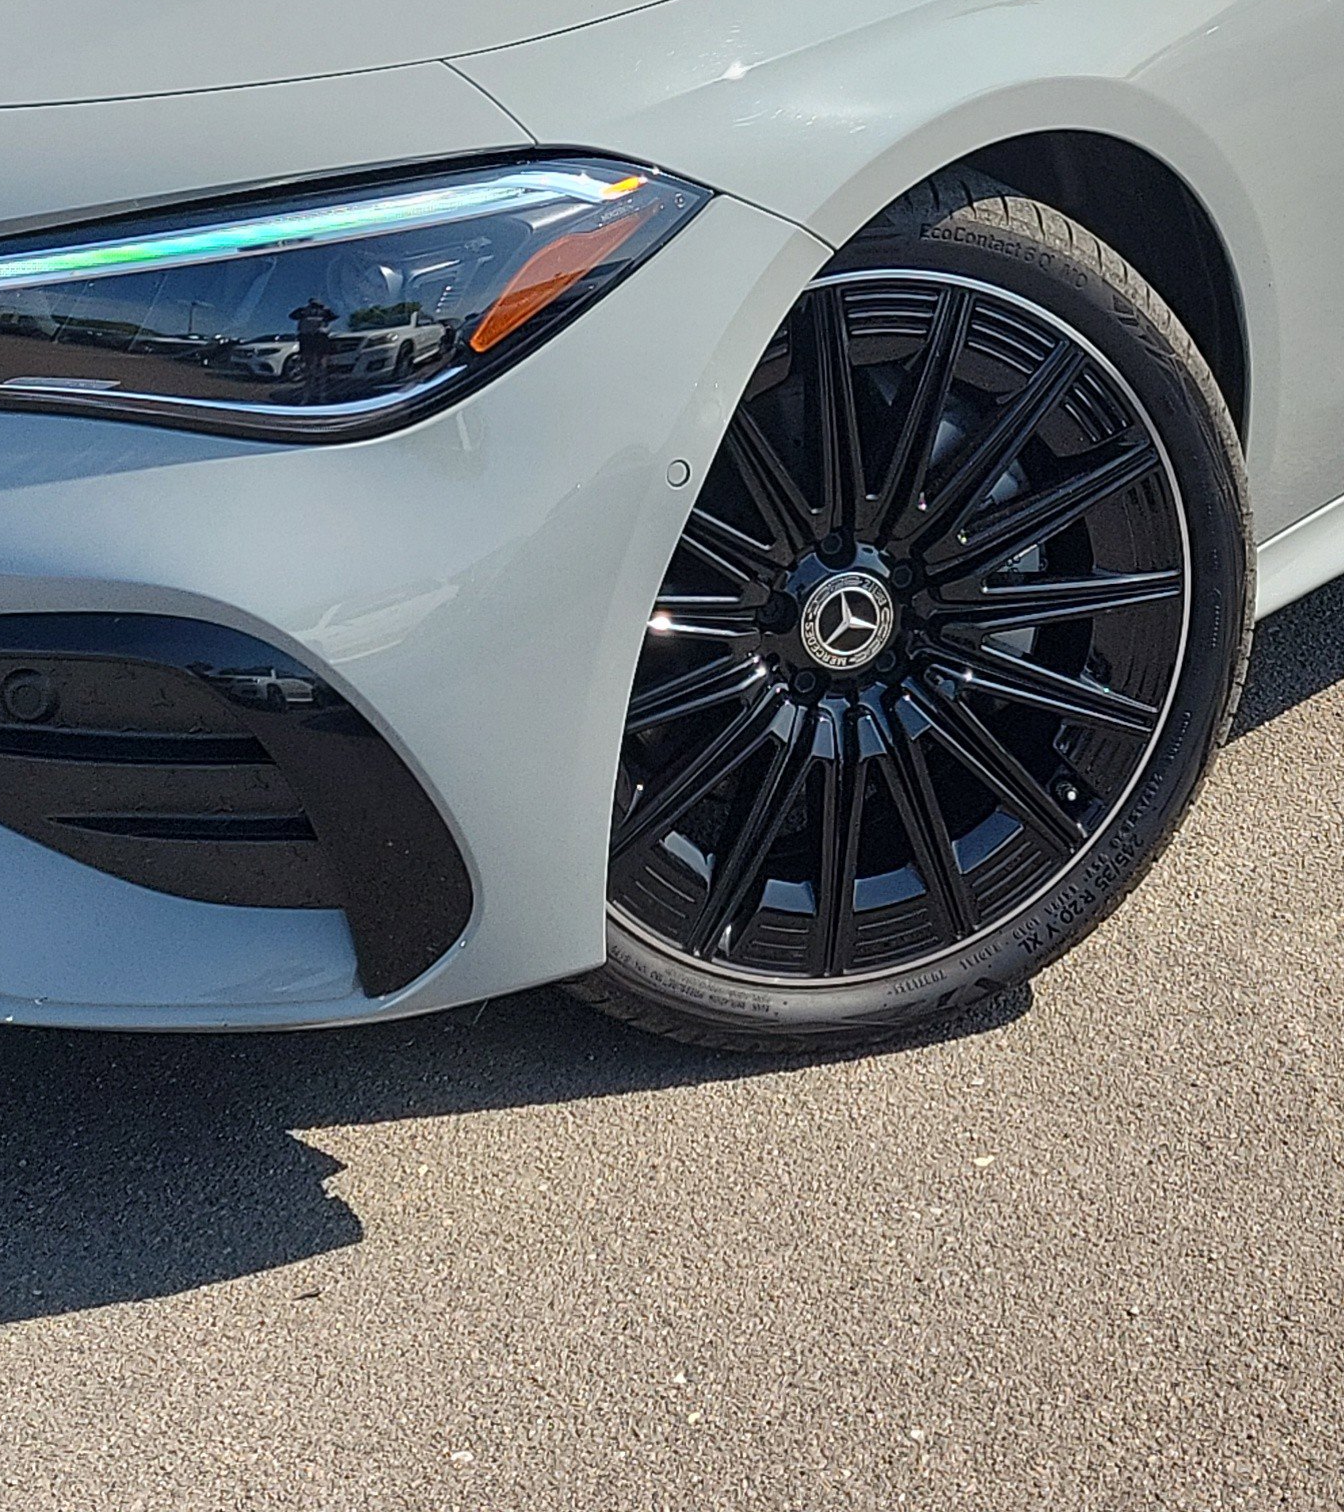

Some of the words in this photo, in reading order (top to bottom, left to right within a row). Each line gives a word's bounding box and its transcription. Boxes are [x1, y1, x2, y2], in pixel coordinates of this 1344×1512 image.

[920, 223, 1023, 257] EcoContact
[805, 621, 848, 667] MERCEDES
[1093, 833, 1145, 892] 245/35
[1017, 931, 1044, 955] XL
